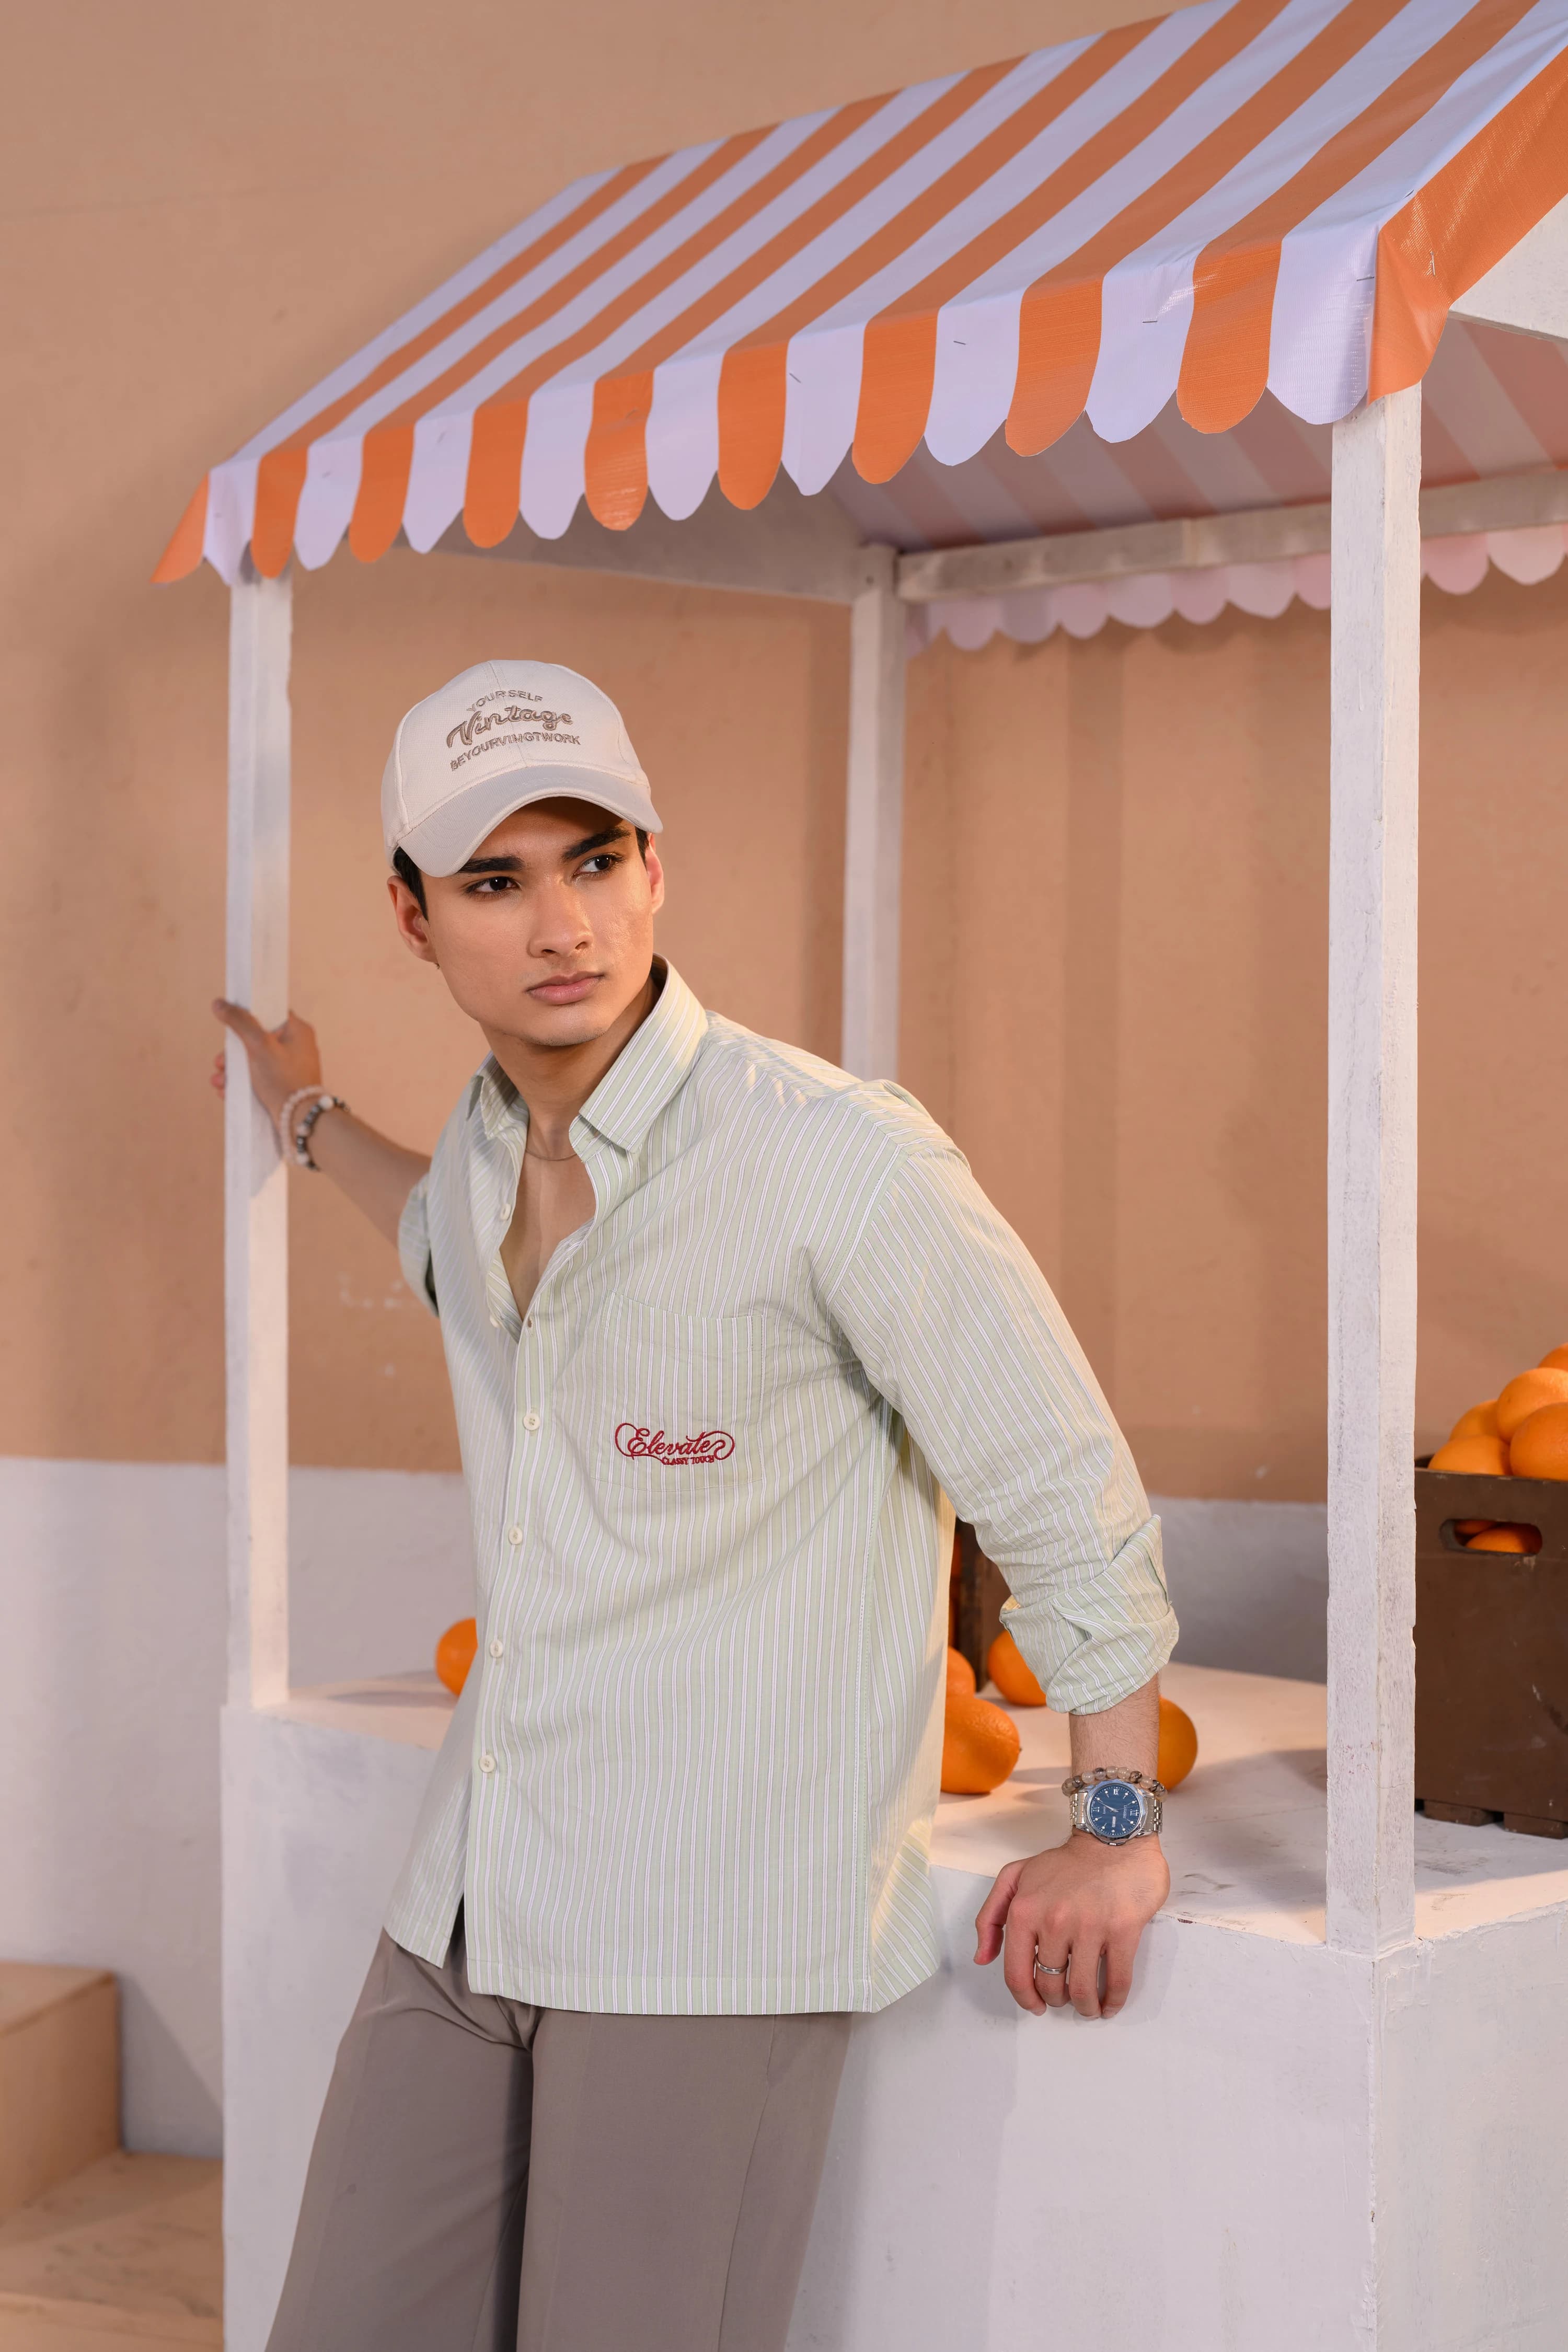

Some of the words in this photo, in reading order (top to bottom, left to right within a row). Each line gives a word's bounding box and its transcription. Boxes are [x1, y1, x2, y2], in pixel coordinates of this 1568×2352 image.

[466, 689, 543, 712] YOURSELF
[446, 706, 573, 748] Vintage
[615, 1423, 735, 1460] Elevate
